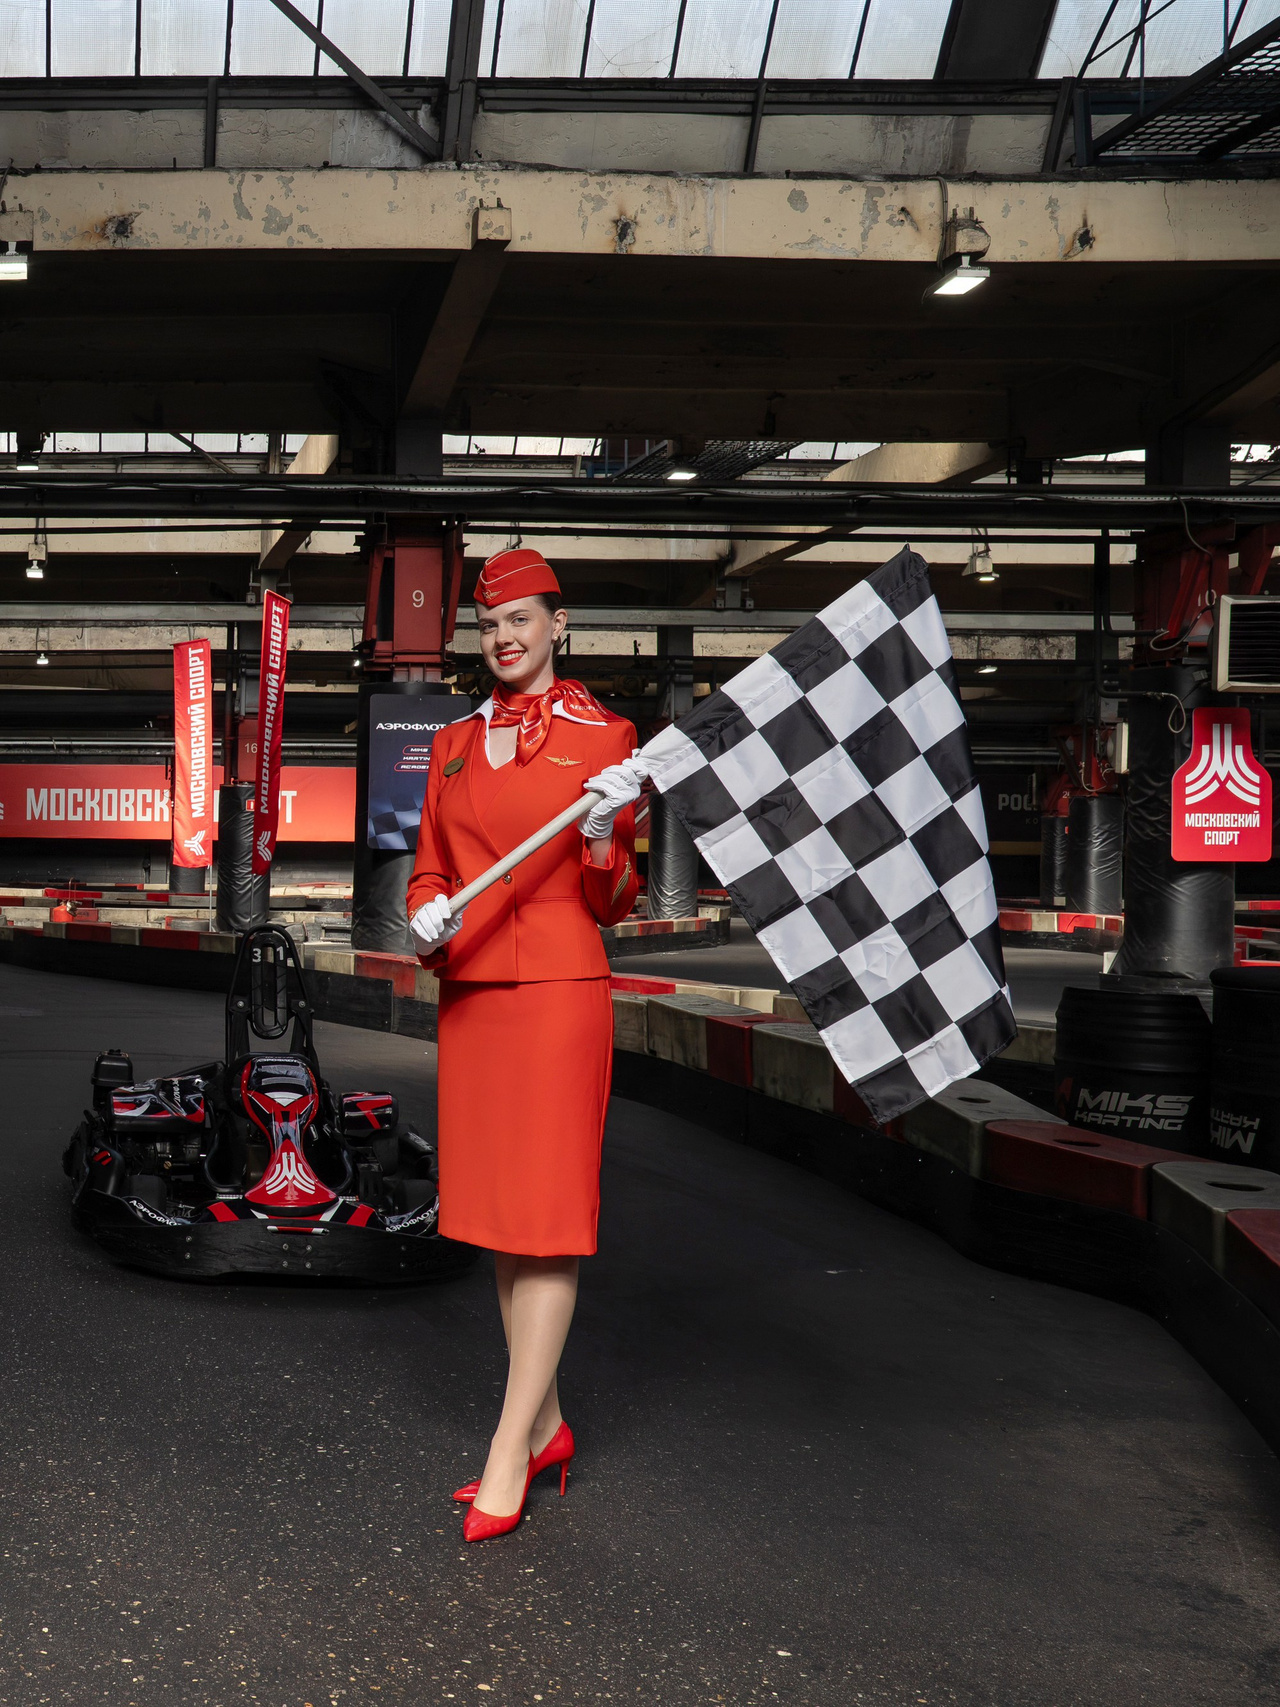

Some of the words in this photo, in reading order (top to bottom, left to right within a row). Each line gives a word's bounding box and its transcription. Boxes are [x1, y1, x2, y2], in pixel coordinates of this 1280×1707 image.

[412, 589, 425, 608] 9
[268, 601, 283, 669] СПОРТ
[188, 647, 206, 700] СПОРТ
[187, 702, 206, 818] МОСКОВСКИЙ
[244, 743, 258, 754] 16
[1185, 810, 1260, 828] МОСКОВСКИЙ
[1204, 830, 1240, 846] СПОРТ
[1077, 1087, 1195, 1117] MIKS
[1074, 1109, 1185, 1131] KARTING
[129, 1199, 182, 1227] АЭРОФЛО
